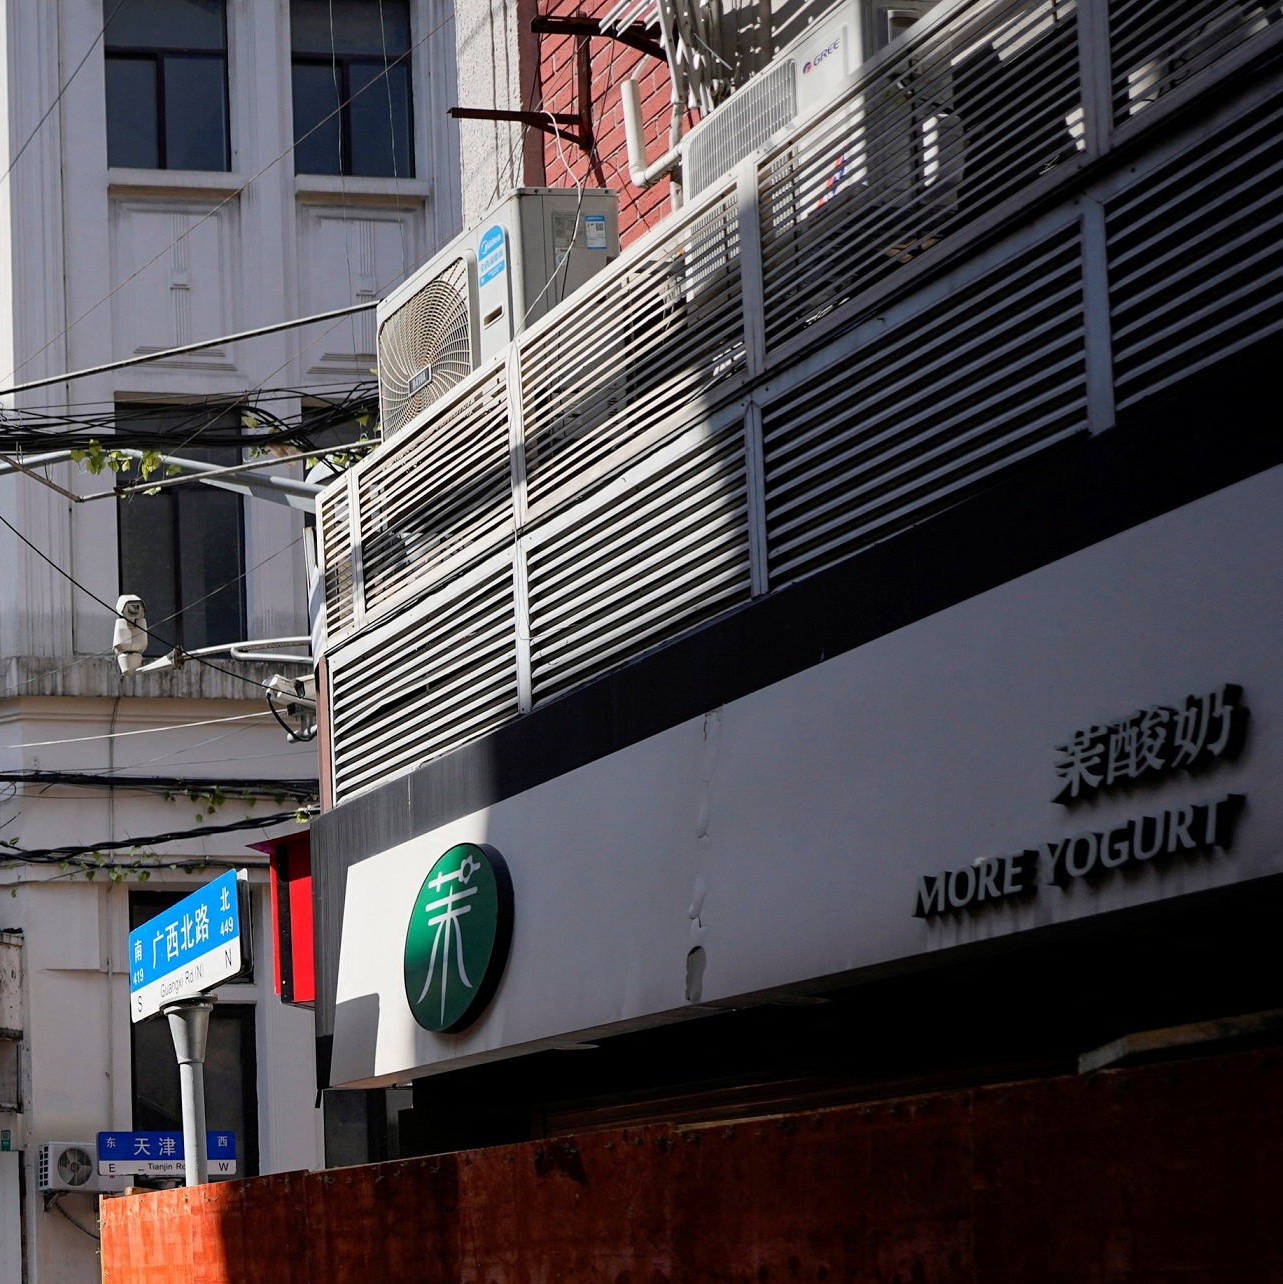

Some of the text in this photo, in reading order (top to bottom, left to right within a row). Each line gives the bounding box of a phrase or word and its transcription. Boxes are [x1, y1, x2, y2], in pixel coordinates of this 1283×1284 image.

[813, 38, 840, 66] GREE
[1053, 690, 1234, 801] 茉酸奶
[913, 796, 1230, 917] MORE YOGURT
[133, 916, 234, 985] 419 449
[134, 886, 231, 969] 南 广西北路 北
[137, 996, 144, 1013] S
[160, 980, 184, 998] Guangxi
[224, 947, 232, 969] N
[106, 1136, 228, 1156] 东 天津 西
[109, 1163, 116, 1173] E
[147, 1162, 173, 1172] Tianjin
[218, 1163, 229, 1172] W
